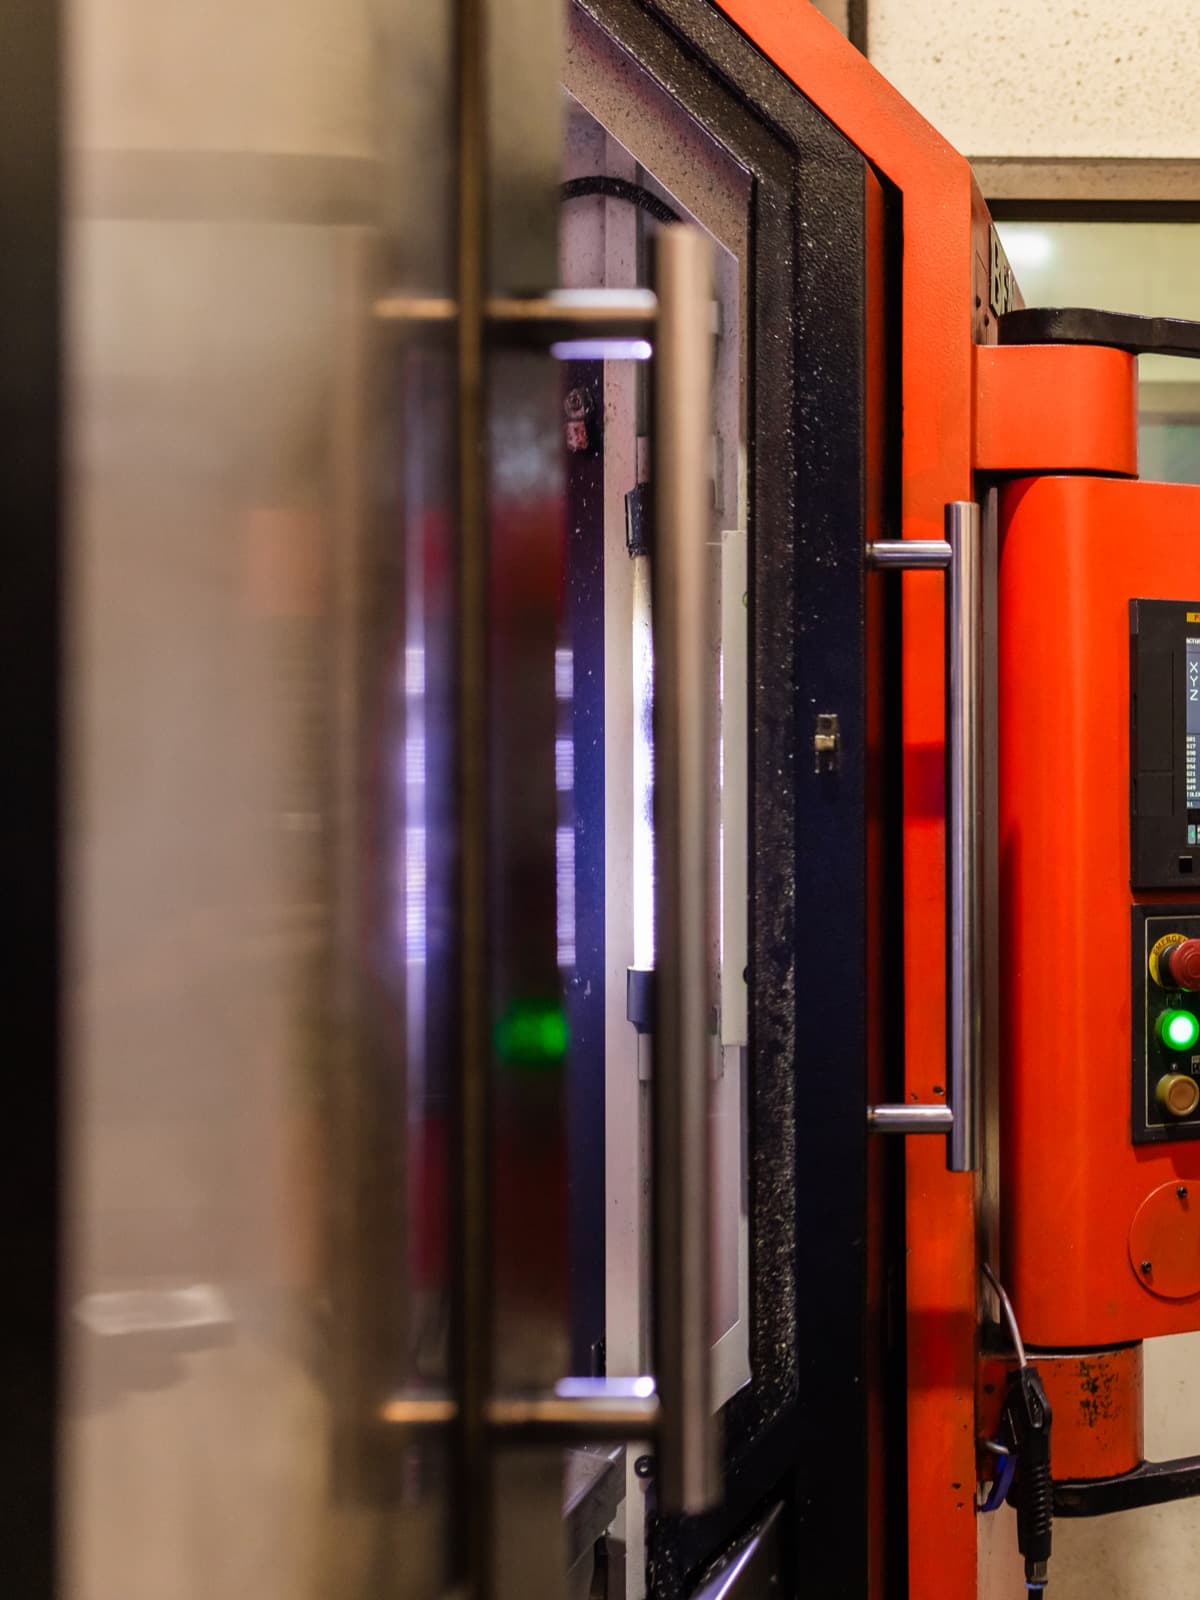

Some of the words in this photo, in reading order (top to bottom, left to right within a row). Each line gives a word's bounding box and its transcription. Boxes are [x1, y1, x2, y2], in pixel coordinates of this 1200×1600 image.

[1189, 662, 1198, 673] X
[1190, 675, 1198, 687] Y
[1190, 689, 1198, 702] Z
